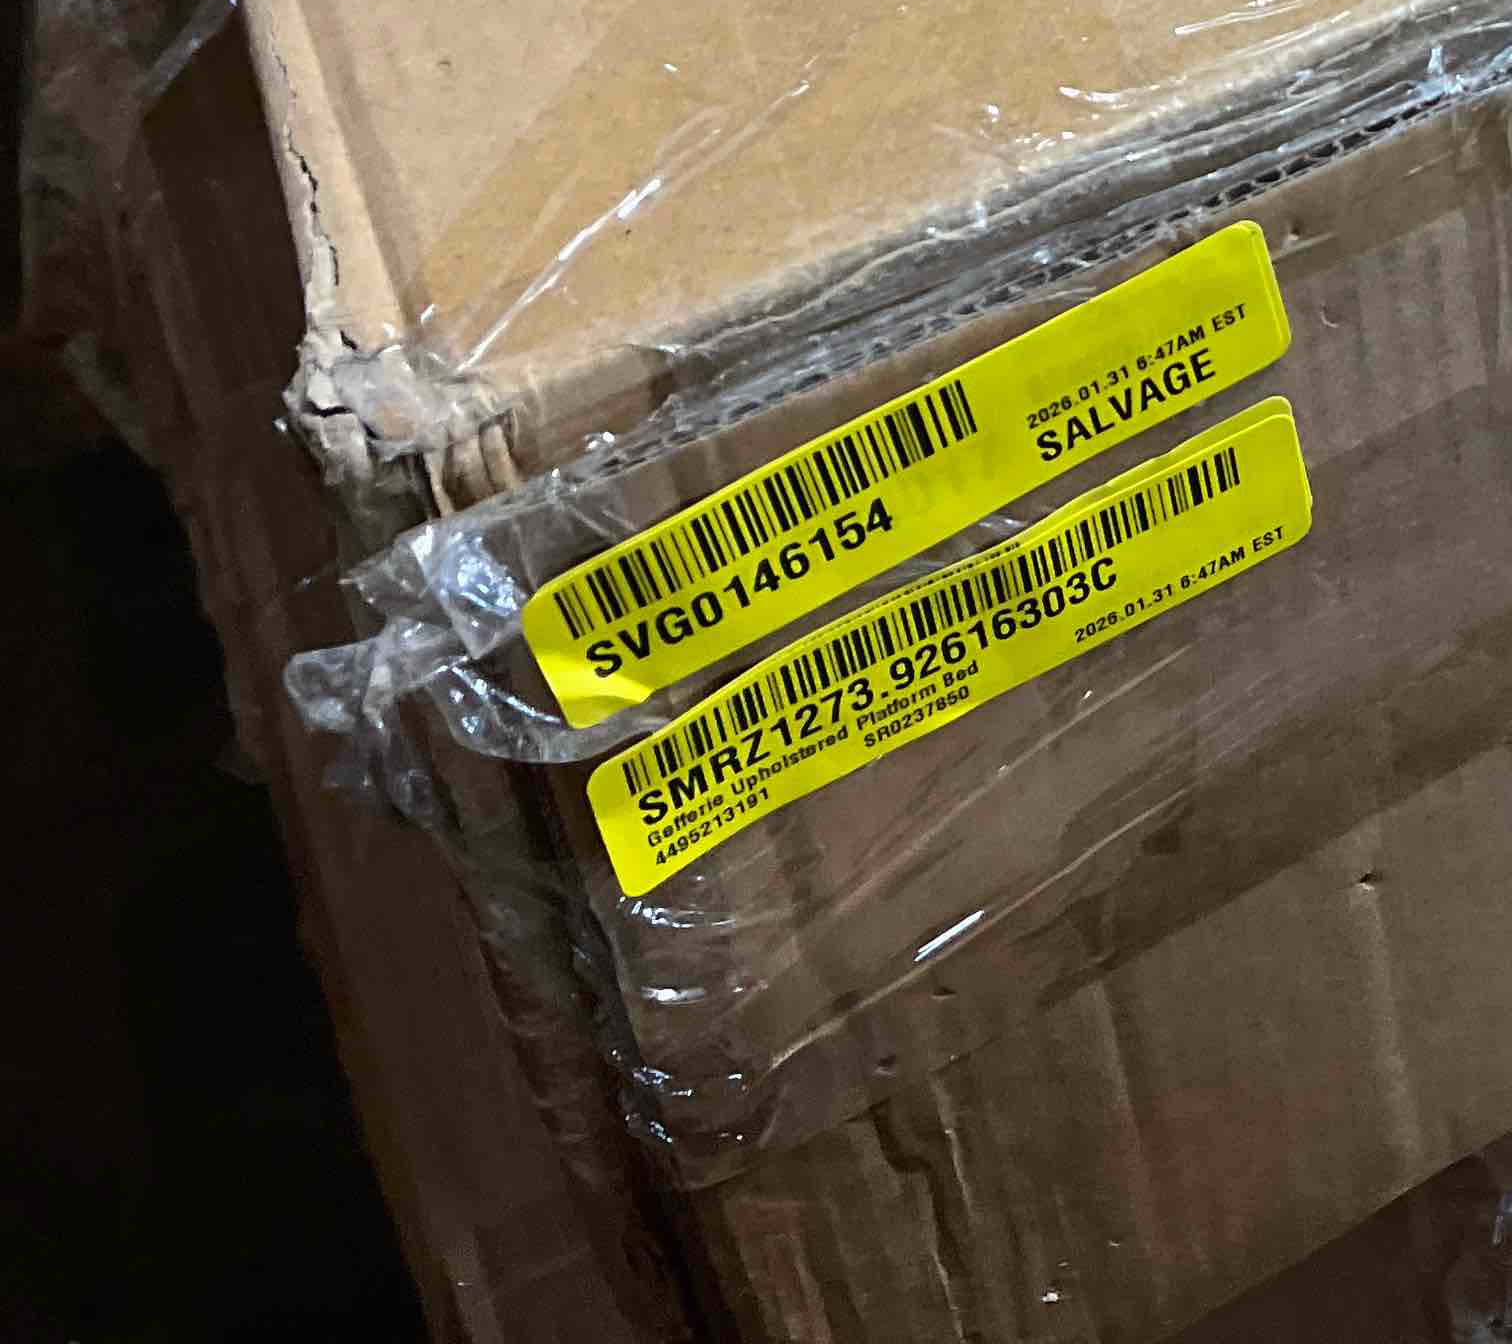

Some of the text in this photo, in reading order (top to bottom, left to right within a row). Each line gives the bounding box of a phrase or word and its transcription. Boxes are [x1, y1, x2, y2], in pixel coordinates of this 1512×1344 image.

[1027, 303, 1248, 430] 2026.01.31 6:47AM EST
[1035, 348, 1216, 463] SALVAGE
[586, 498, 895, 679] SVG0146154
[1075, 526, 1285, 643] 2026.01.31 6:47AM EST
[637, 556, 1118, 826] SMRZ1273.92616303C
[647, 660, 979, 848] Gefferie Upholstered Platform Bed
[654, 686, 970, 866] 4495213191 SR0237850
